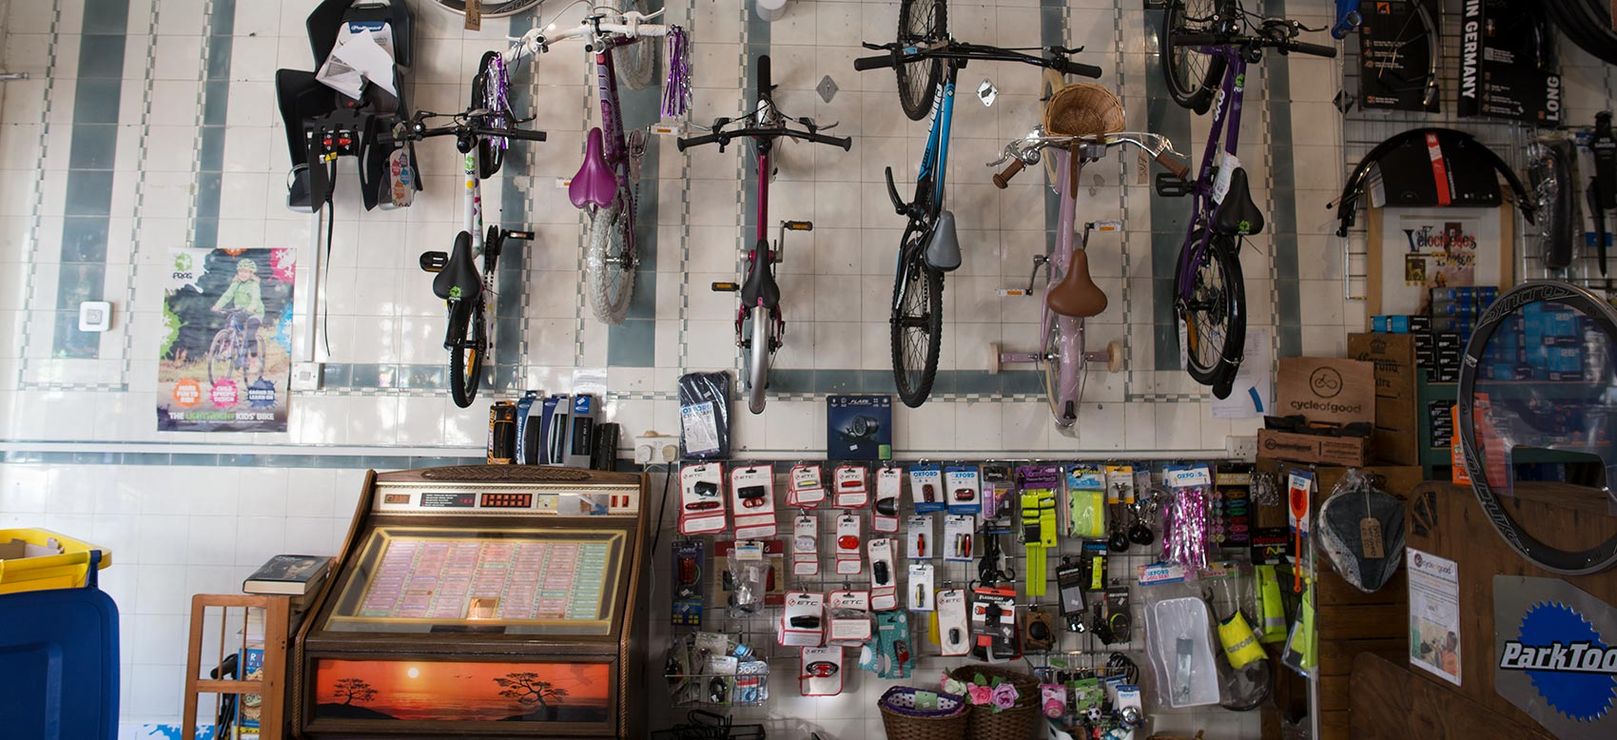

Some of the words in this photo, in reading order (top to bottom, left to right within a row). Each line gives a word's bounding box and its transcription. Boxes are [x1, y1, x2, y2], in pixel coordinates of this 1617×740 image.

[1462, 21, 1480, 99] GERMANY
[1546, 76, 1560, 121] LONG
[169, 412, 185, 420] THE
[256, 412, 274, 420] BIKE
